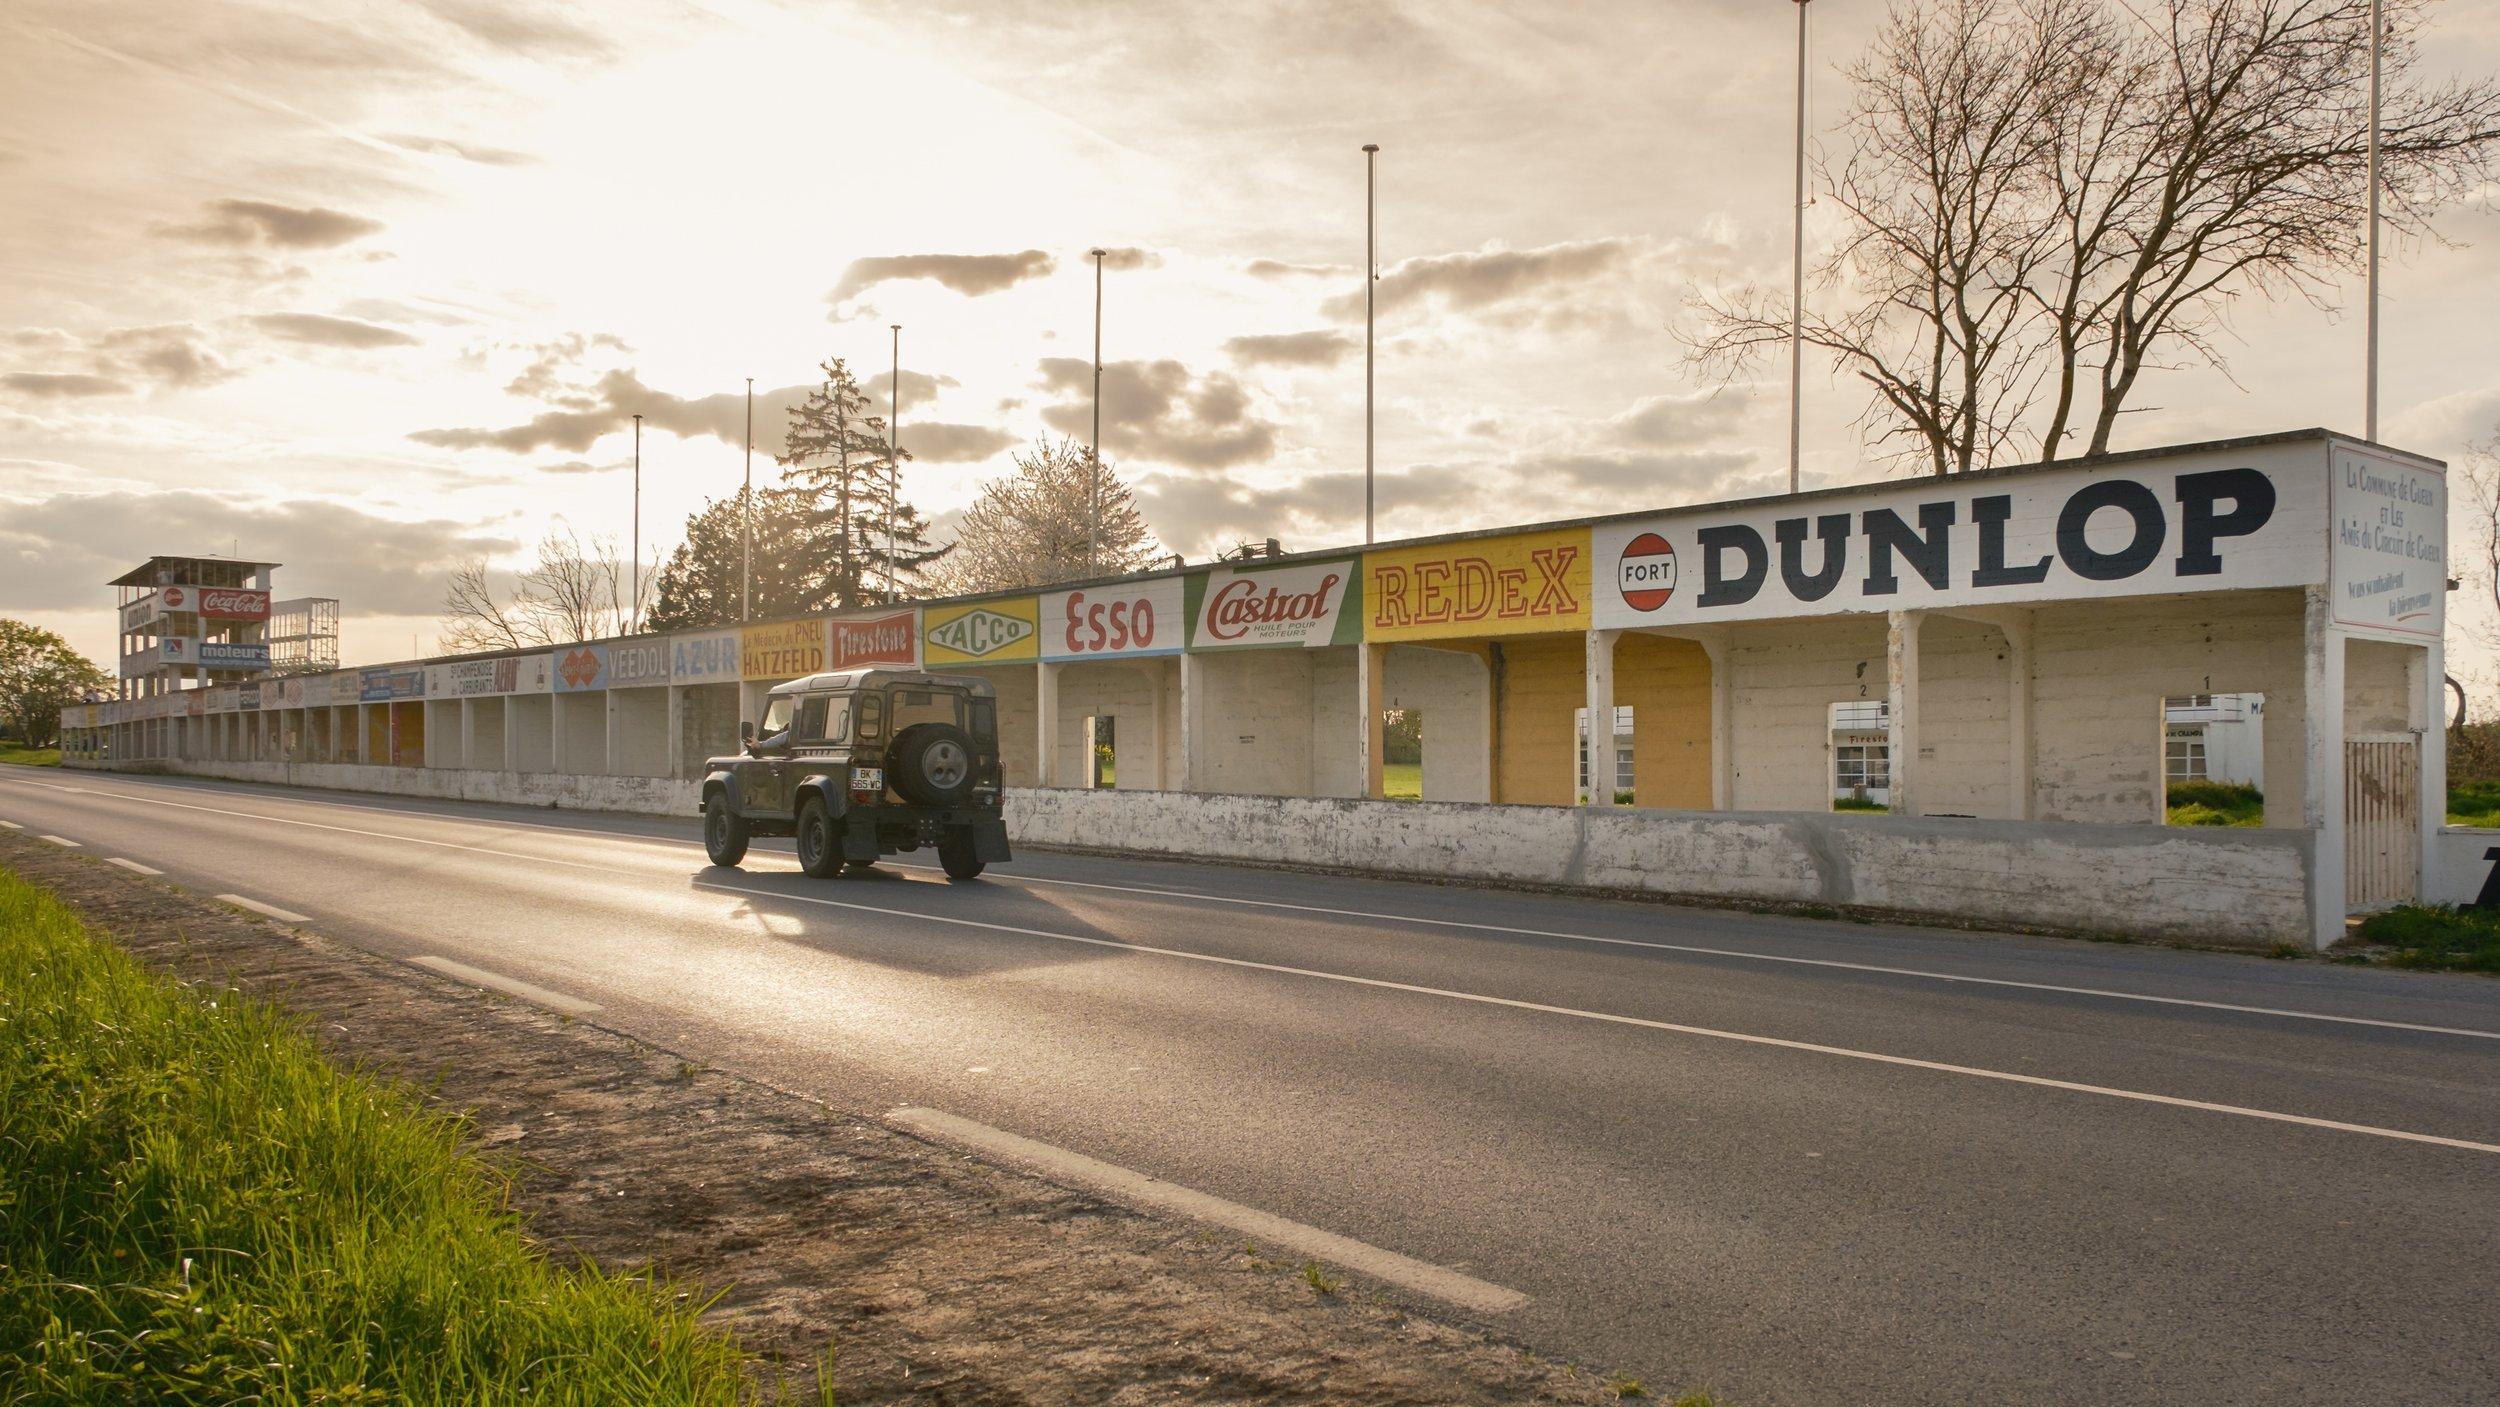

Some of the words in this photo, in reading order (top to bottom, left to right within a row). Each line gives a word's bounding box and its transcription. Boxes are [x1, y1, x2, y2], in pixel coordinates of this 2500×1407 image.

[1697, 468, 2276, 608] DUNLOP
[1625, 562, 1671, 583] FORT
[1207, 573, 1339, 641] Castrol
[743, 634, 751, 649] Le
[784, 628, 793, 645] du
[795, 620, 823, 644] PNEU
[937, 612, 1020, 654] YACCO
[1065, 592, 1154, 653] ESSO
[1253, 623, 1281, 632] HUILE
[1288, 621, 1316, 631] POUR
[1259, 629, 1307, 639] MOTEURS
[202, 646, 270, 659] moteurs
[674, 637, 737, 676] AZUR
[838, 623, 907, 665] Firestone
[609, 648, 667, 678] VEEDOL
[743, 648, 823, 677] HATZFELD
[1860, 684, 1867, 697] 2
[2204, 676, 2210, 690] 1
[860, 769, 871, 779] BK
